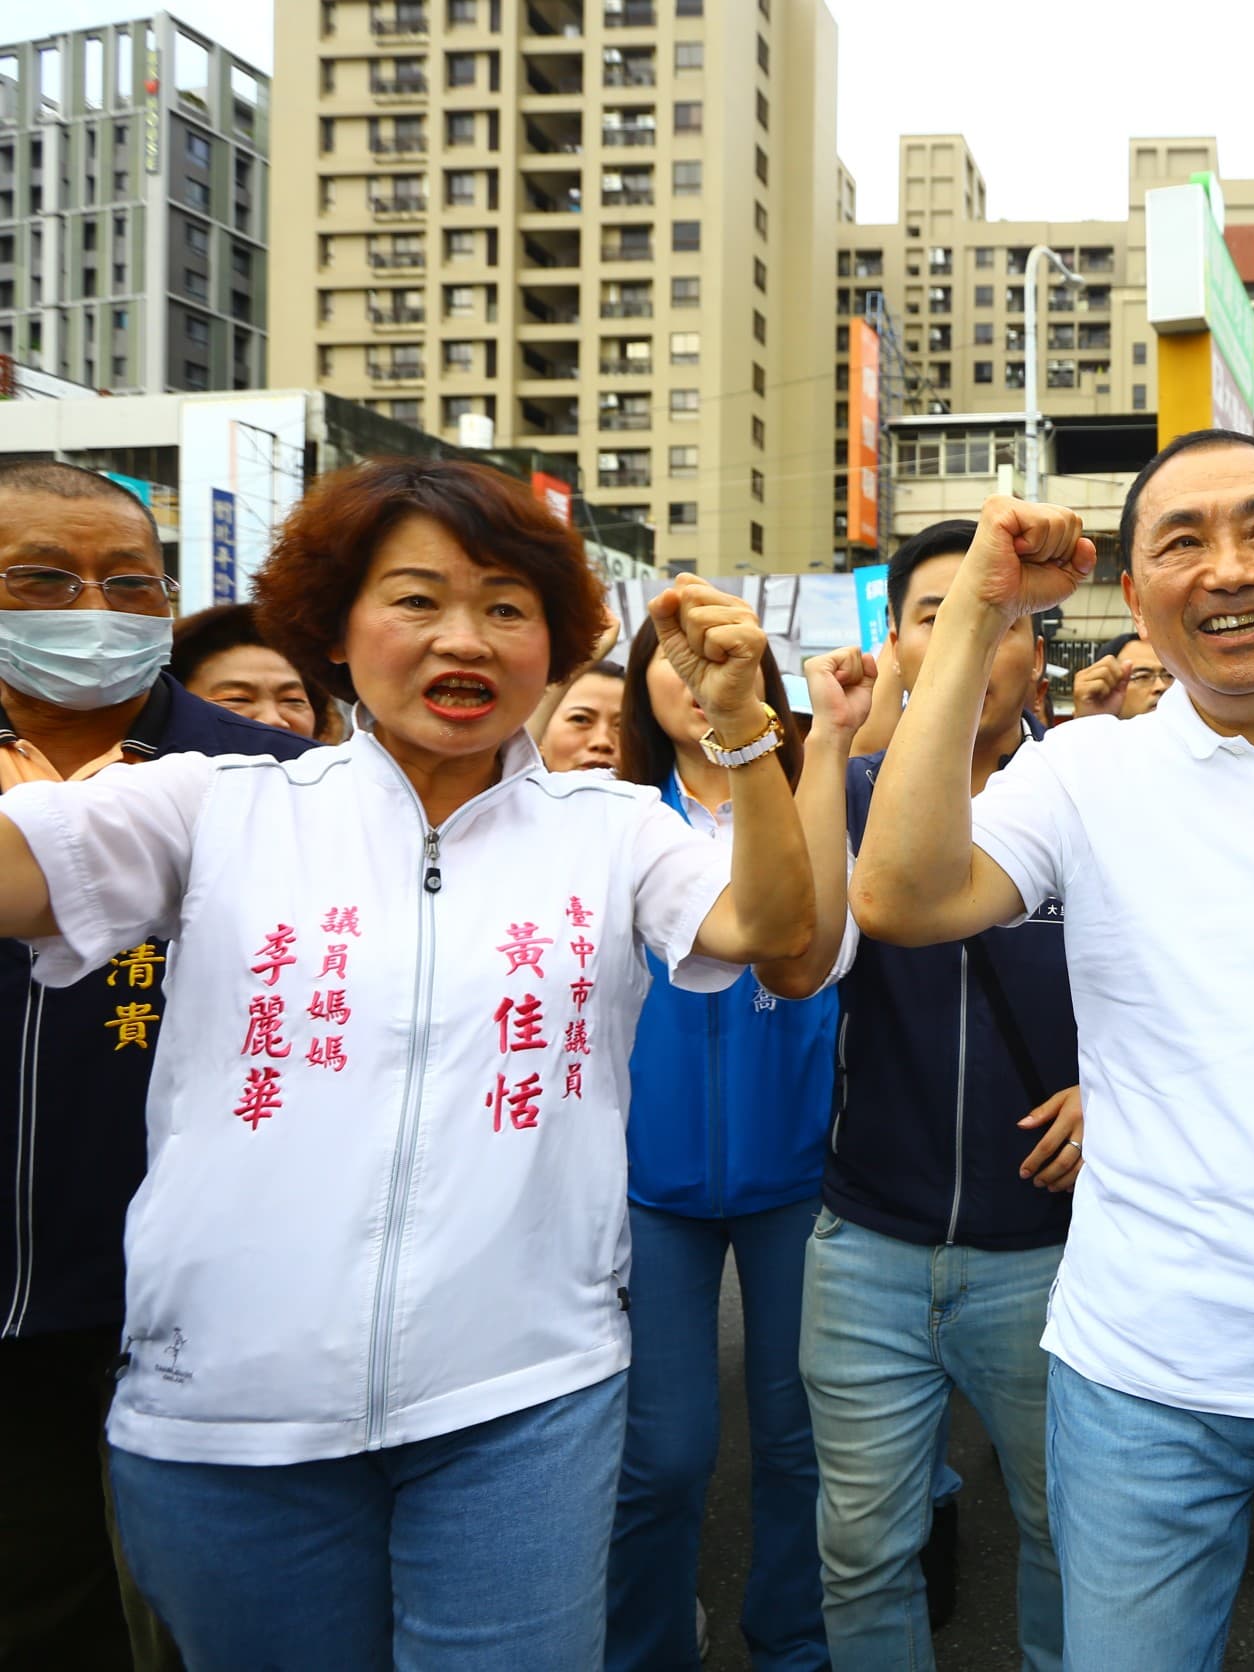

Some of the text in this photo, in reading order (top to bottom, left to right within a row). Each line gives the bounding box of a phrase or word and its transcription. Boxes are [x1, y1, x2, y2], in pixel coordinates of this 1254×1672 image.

[105, 940, 166, 1052] 清貴
[232, 922, 298, 1131] 李麗華
[304, 904, 362, 1073] 議員媽媽
[485, 921, 554, 1134] 黃佳恬
[563, 895, 595, 1100] 臺中市議員
